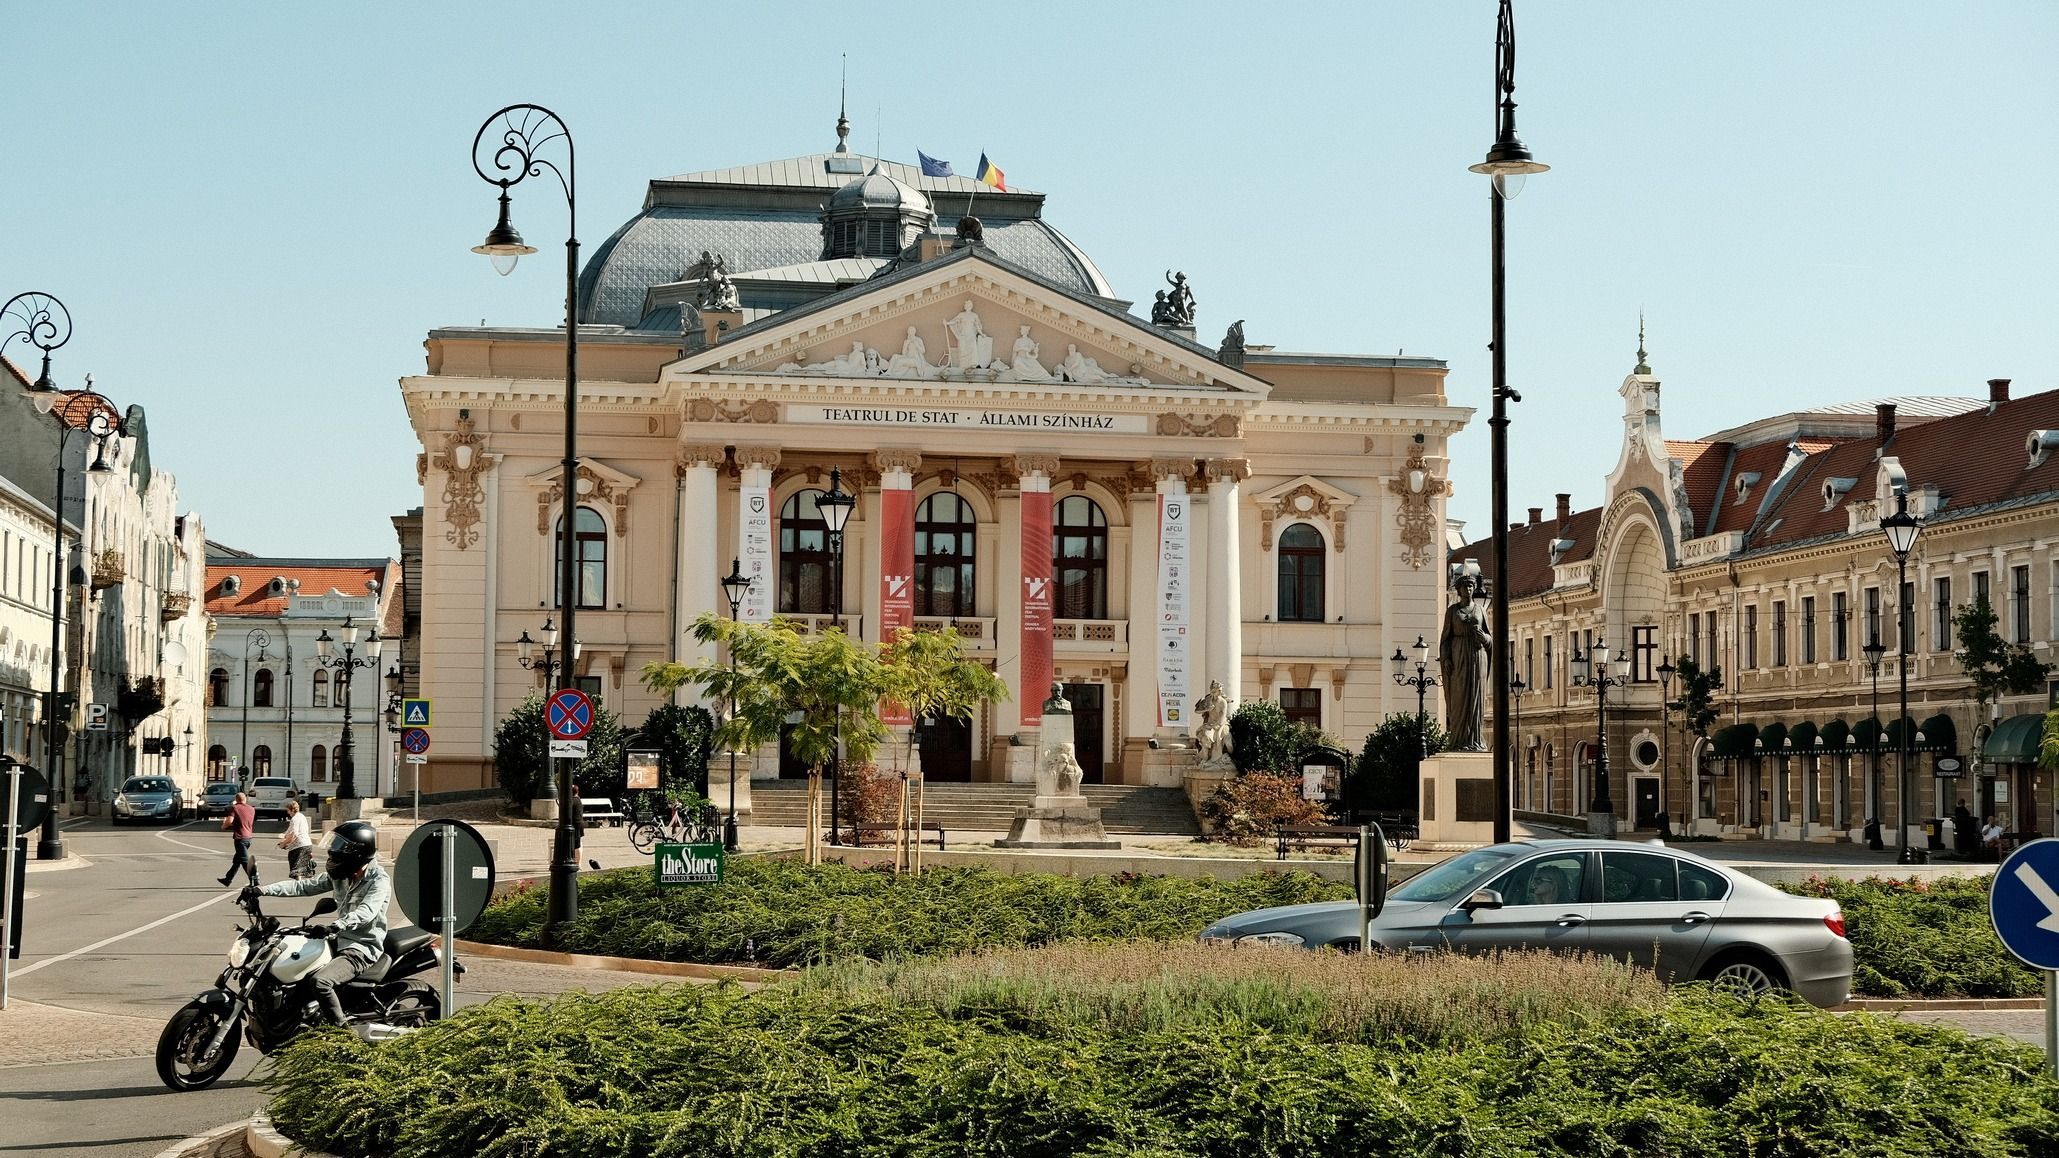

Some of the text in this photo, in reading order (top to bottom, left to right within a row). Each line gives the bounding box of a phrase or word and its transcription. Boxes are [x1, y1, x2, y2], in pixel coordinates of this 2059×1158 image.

[822, 408, 1114, 429] TEATRUL DE STAT ÁLLAMI SZÍNHÁZ
[88, 704, 106, 723] P
[661, 847, 718, 875] theStore
